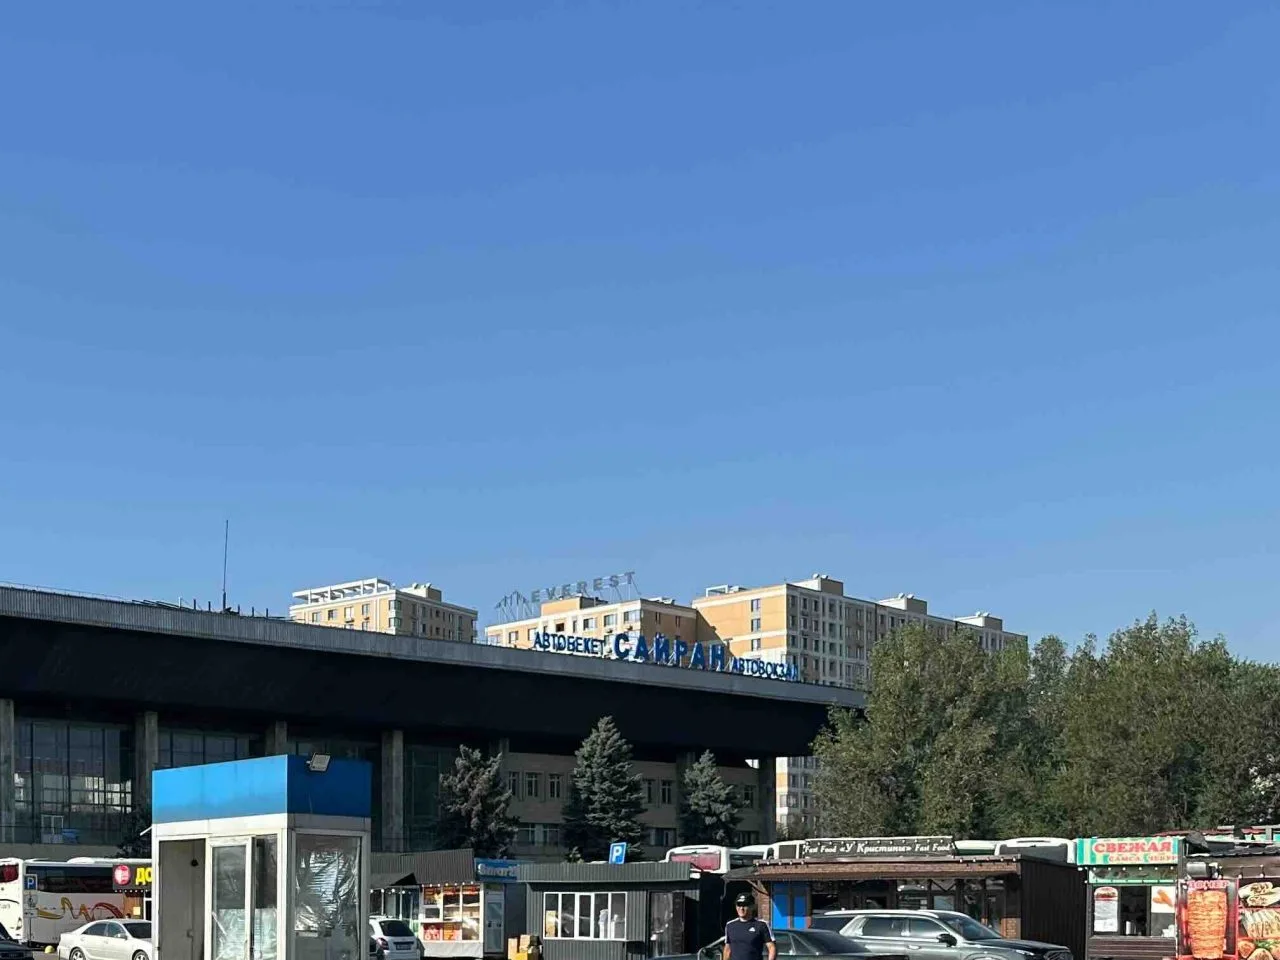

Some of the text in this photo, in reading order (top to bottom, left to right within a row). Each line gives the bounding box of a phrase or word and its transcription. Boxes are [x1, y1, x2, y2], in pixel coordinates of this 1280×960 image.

[531, 571, 635, 602] EVEREST
[534, 631, 799, 681] АВТОБЕКЕТ САЙРАН АВТОВОКЗАЛ
[613, 846, 622, 861] P
[820, 845, 837, 853] Food
[915, 843, 930, 851] Fast
[932, 843, 950, 851] Food
[1093, 841, 1171, 853] СВЕЖАЯ
[27, 878, 34, 889] P
